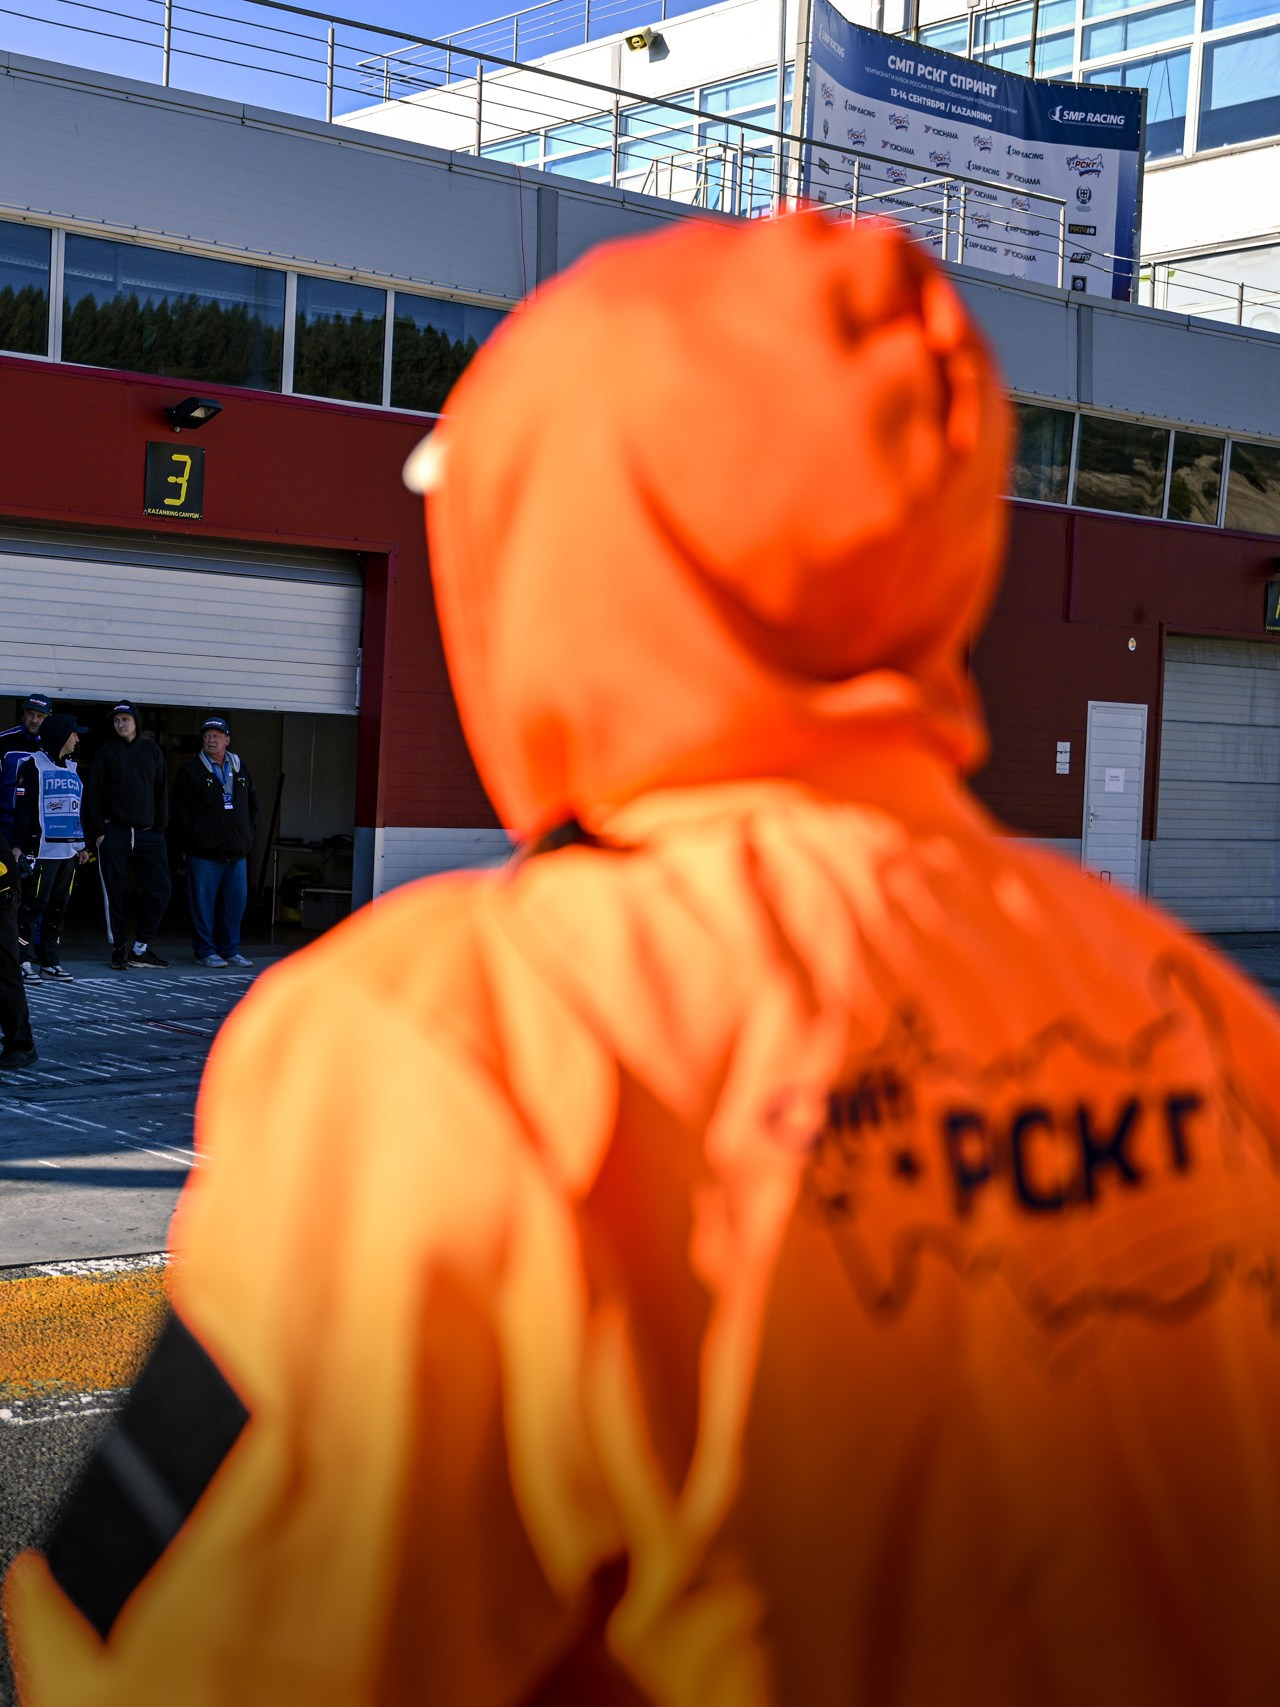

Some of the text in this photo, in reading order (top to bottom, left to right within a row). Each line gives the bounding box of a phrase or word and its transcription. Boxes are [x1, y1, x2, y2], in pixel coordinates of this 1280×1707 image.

[888, 55, 998, 98] СМП РСКГ СПРИНТ
[890, 88, 907, 100] 13-14
[908, 92, 945, 111] СЕНТЯБРЯ
[951, 104, 993, 123] KAZANRING
[858, 106, 876, 118] RACING
[1062, 110, 1086, 122] SMP
[1086, 112, 1125, 125] RACING
[931, 128, 959, 140] YOKOHAMA
[889, 142, 914, 155] YOKOHAMA
[1021, 152, 1044, 160] RACING
[847, 158, 872, 172] YOKAMA
[982, 166, 1000, 176] RACING
[974, 190, 998, 202] YOKOHAMA
[979, 244, 998, 254] RACING
[164, 454, 192, 506] 3
[148, 508, 178, 517] KAZANRING
[943, 1088, 1203, 1219] РСКГ
